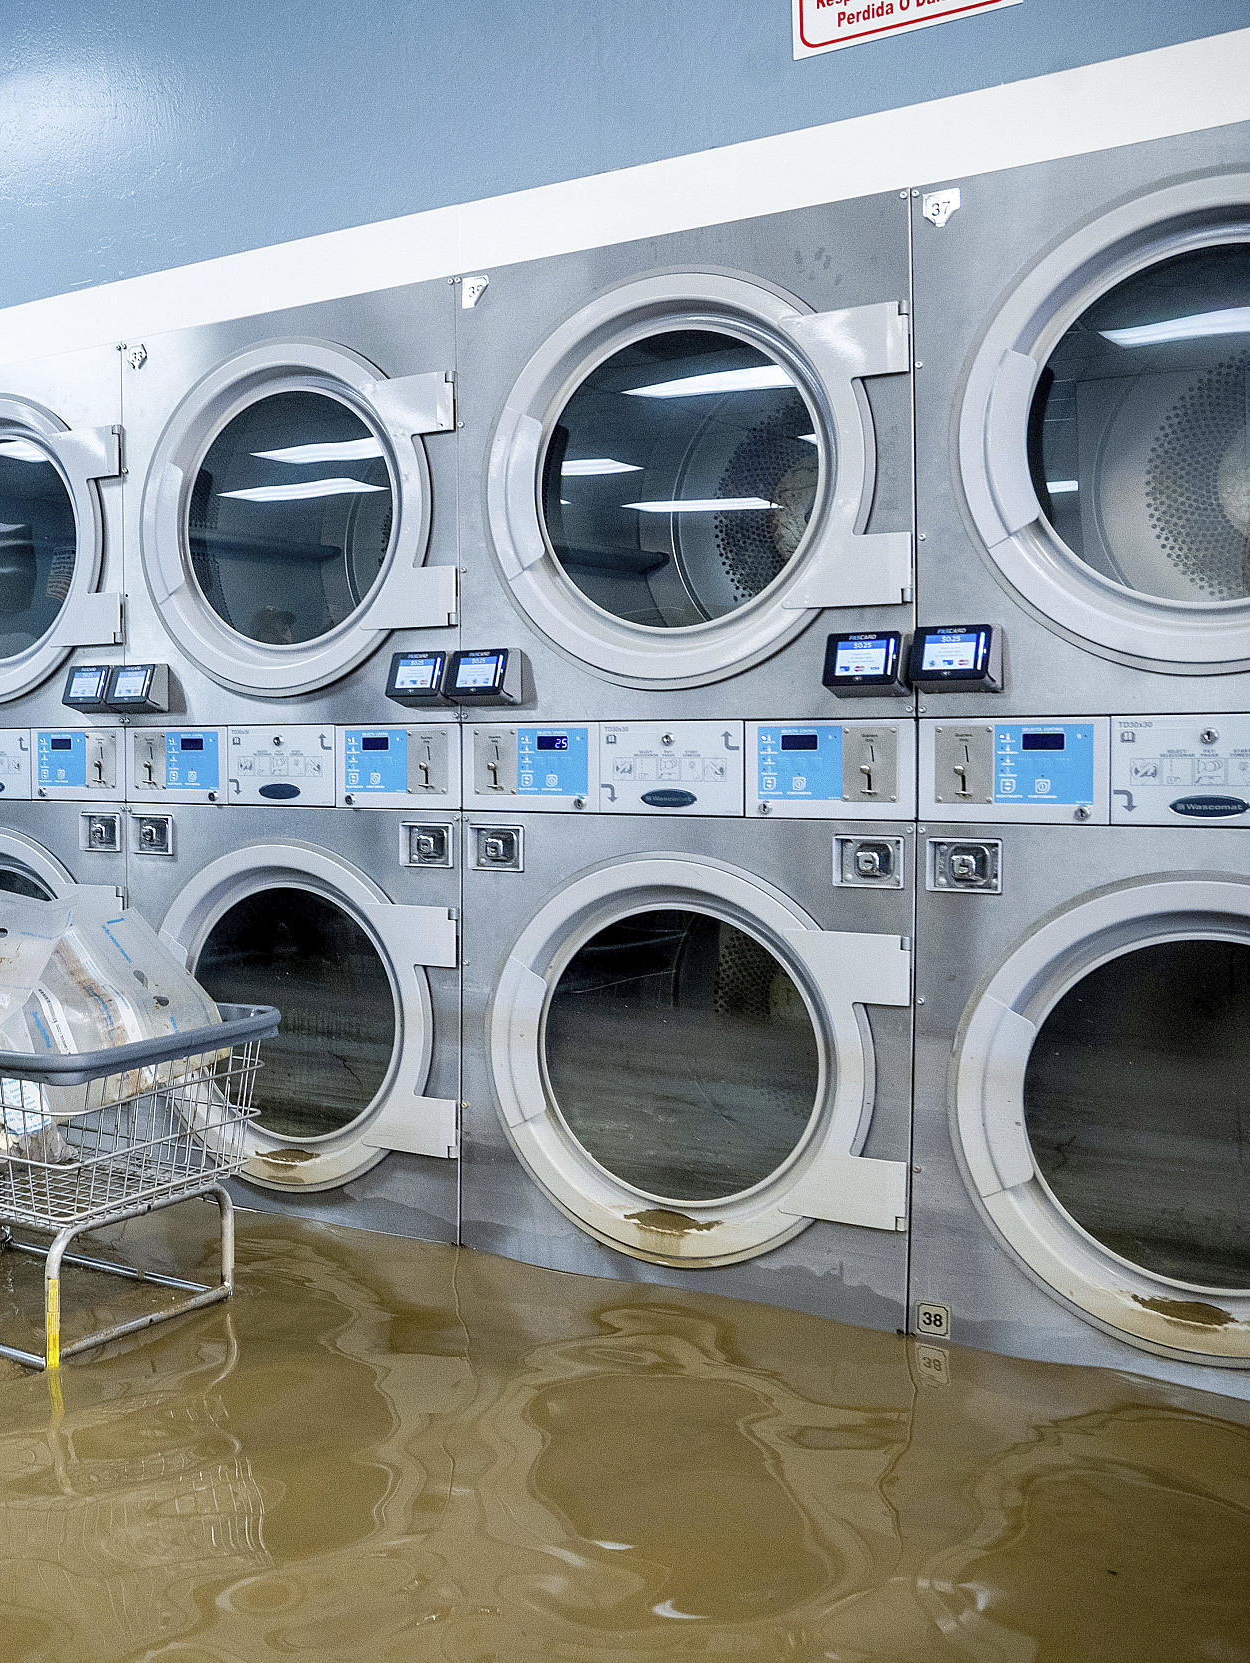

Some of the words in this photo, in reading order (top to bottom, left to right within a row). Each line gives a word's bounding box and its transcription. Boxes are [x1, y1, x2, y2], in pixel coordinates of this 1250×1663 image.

[837, 2, 894, 27] Perdida
[899, 0, 910, 11] O
[931, 201, 951, 217] 37
[941, 635, 961, 643] $0.25
[853, 642, 872, 650] $0.25
[554, 738, 568, 749] 25
[1186, 803, 1244, 811] Wascomat
[922, 1311, 943, 1328] 38
